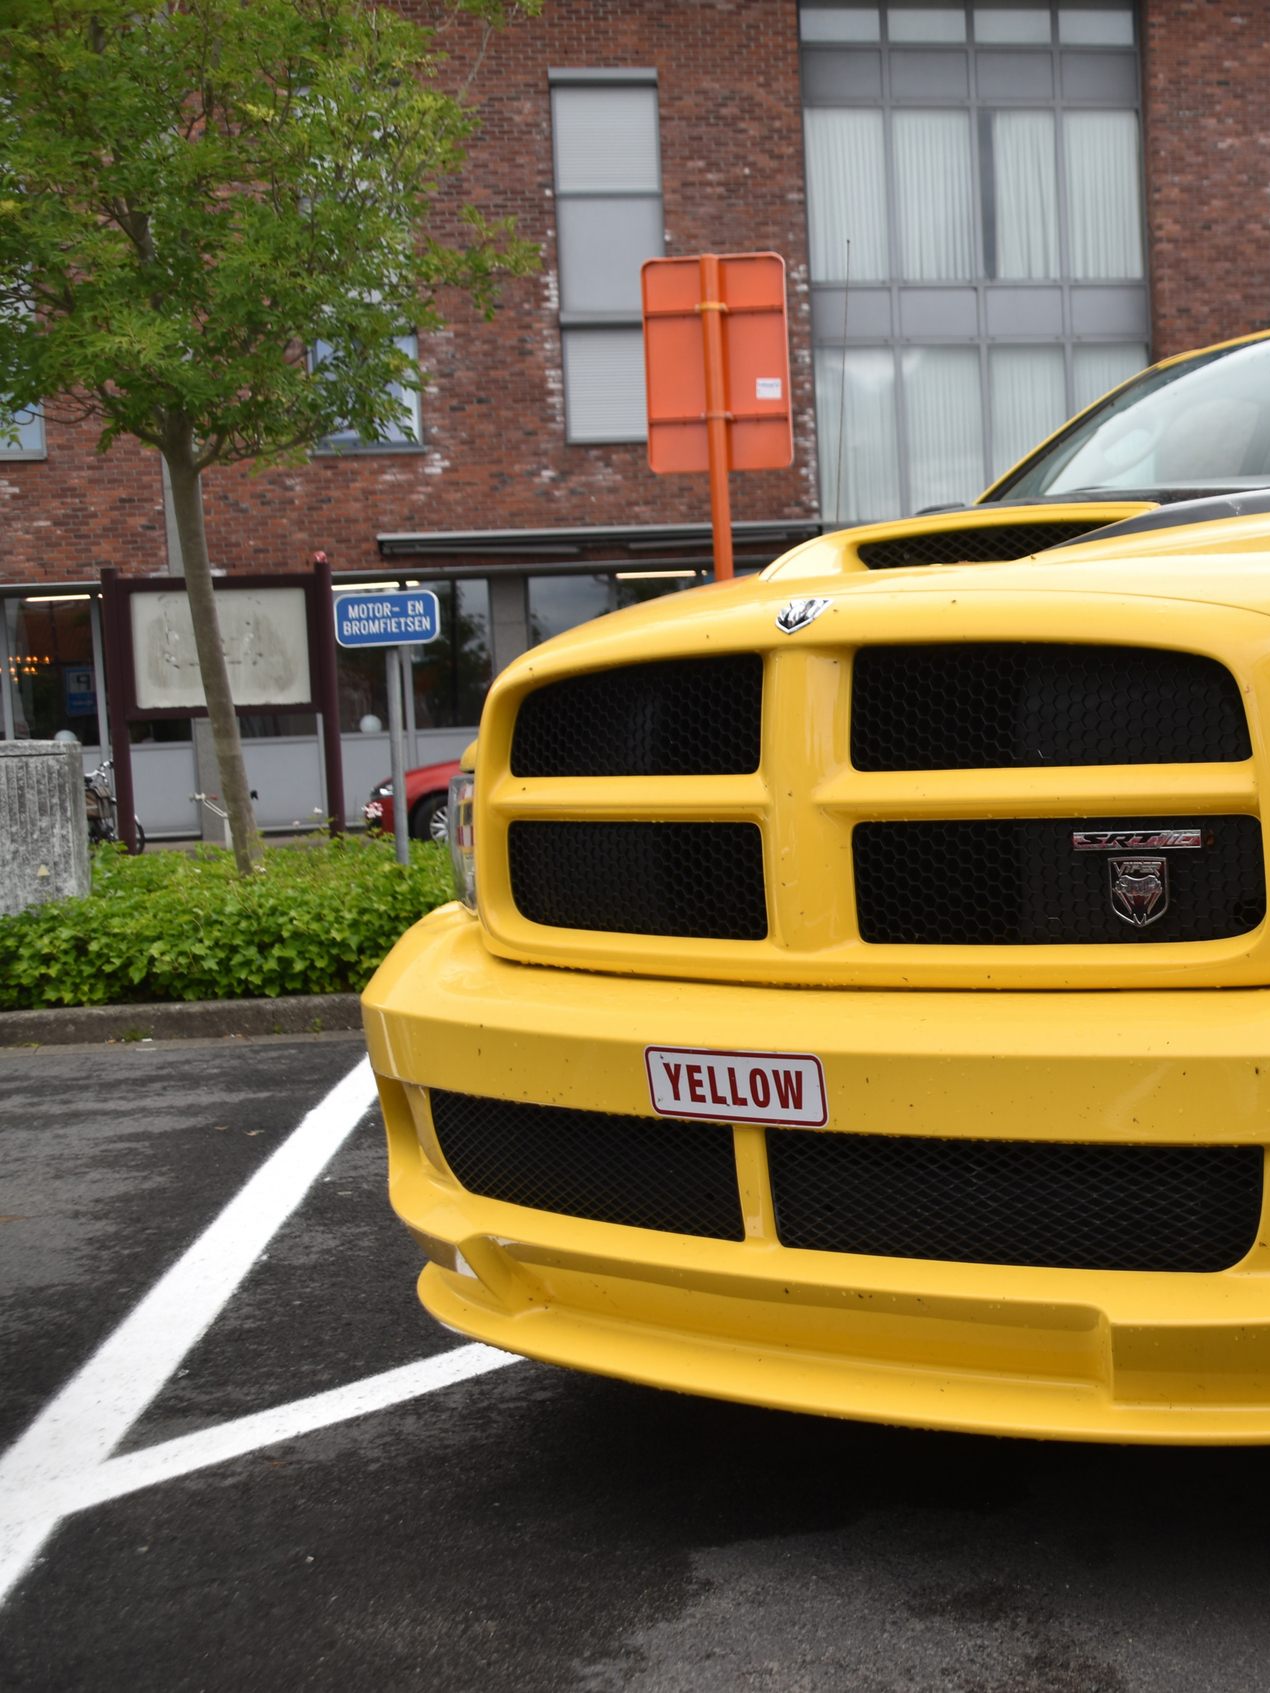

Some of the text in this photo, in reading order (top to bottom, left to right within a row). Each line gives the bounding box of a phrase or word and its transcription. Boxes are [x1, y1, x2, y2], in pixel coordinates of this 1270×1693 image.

[347, 600, 424, 620] MOTOR- EN
[343, 616, 431, 637] BROMFIETSEN
[1112, 861, 1162, 877] VIPER
[662, 1062, 803, 1110] YELLOW
